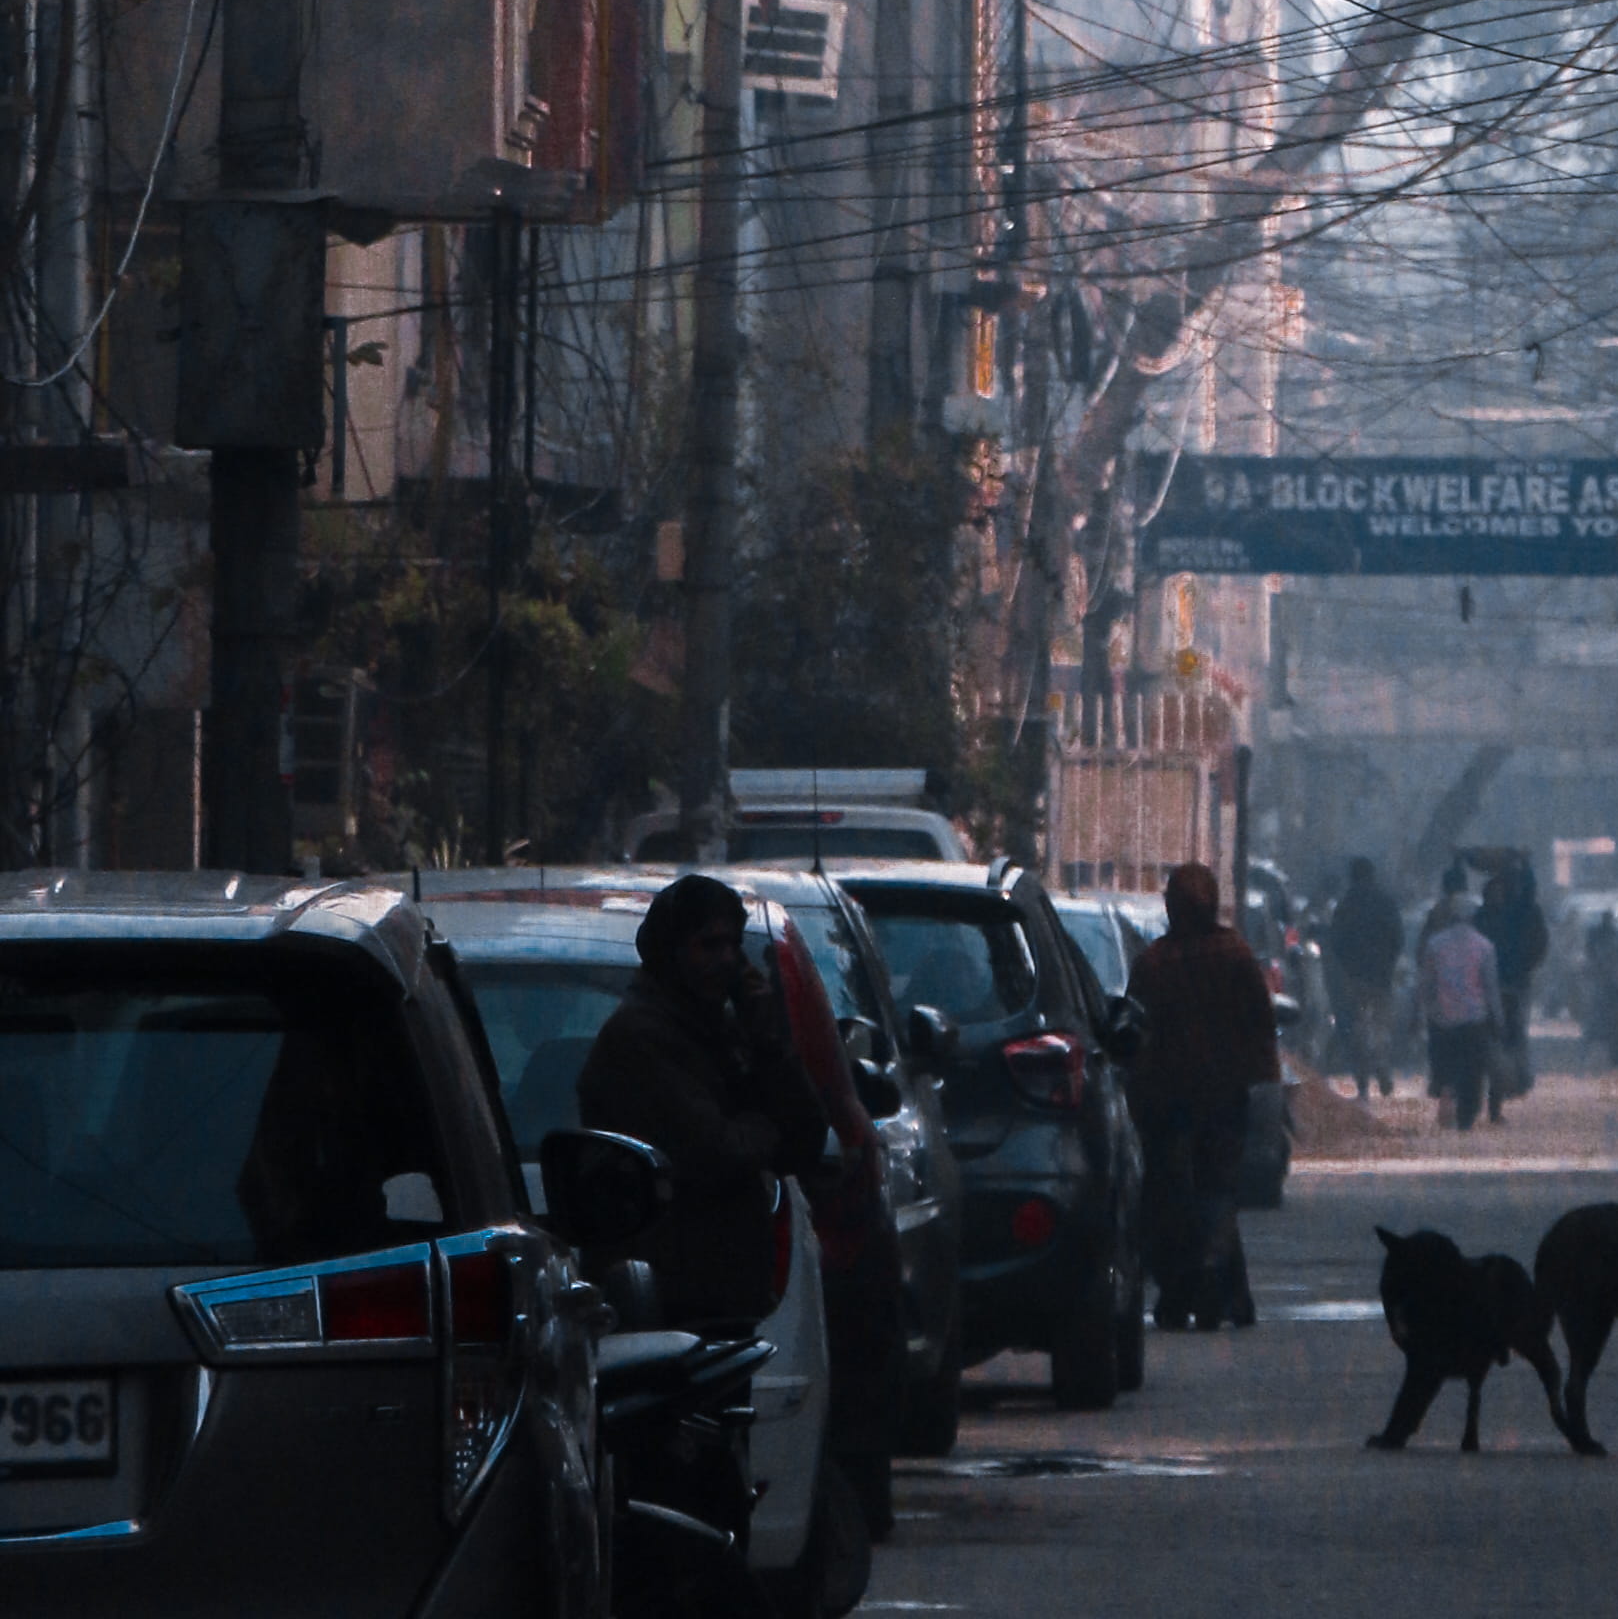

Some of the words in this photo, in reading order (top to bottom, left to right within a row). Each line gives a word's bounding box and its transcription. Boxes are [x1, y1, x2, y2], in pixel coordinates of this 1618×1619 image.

[1401, 474, 1570, 514] WELFARE
[1369, 515, 1560, 536] WELCOMES
[0, 1393, 105, 1447] 966
